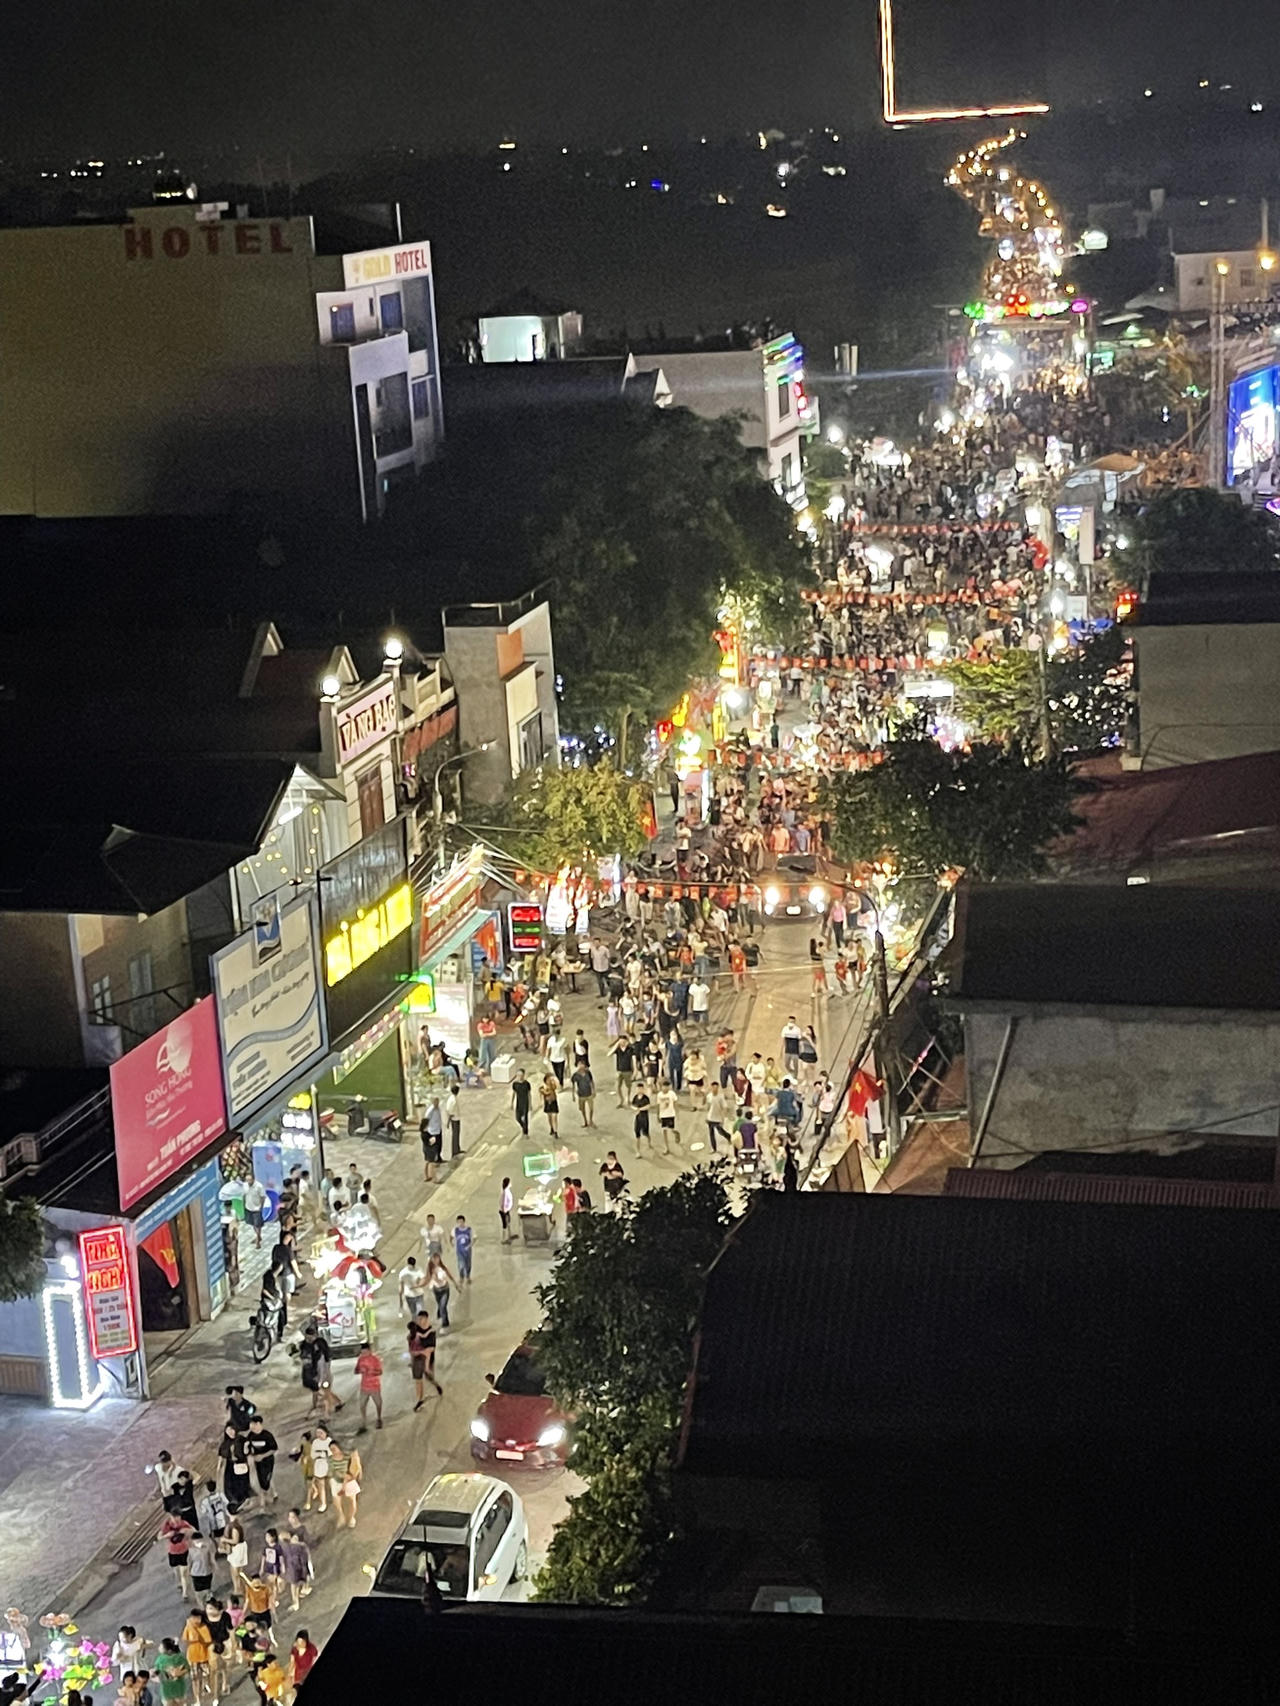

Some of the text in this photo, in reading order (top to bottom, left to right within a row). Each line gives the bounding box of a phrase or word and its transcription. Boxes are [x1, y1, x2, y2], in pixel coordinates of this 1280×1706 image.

[124, 224, 293, 260] HOTEL
[394, 248, 428, 275] HOTEL
[339, 709, 372, 751] VÀNG
